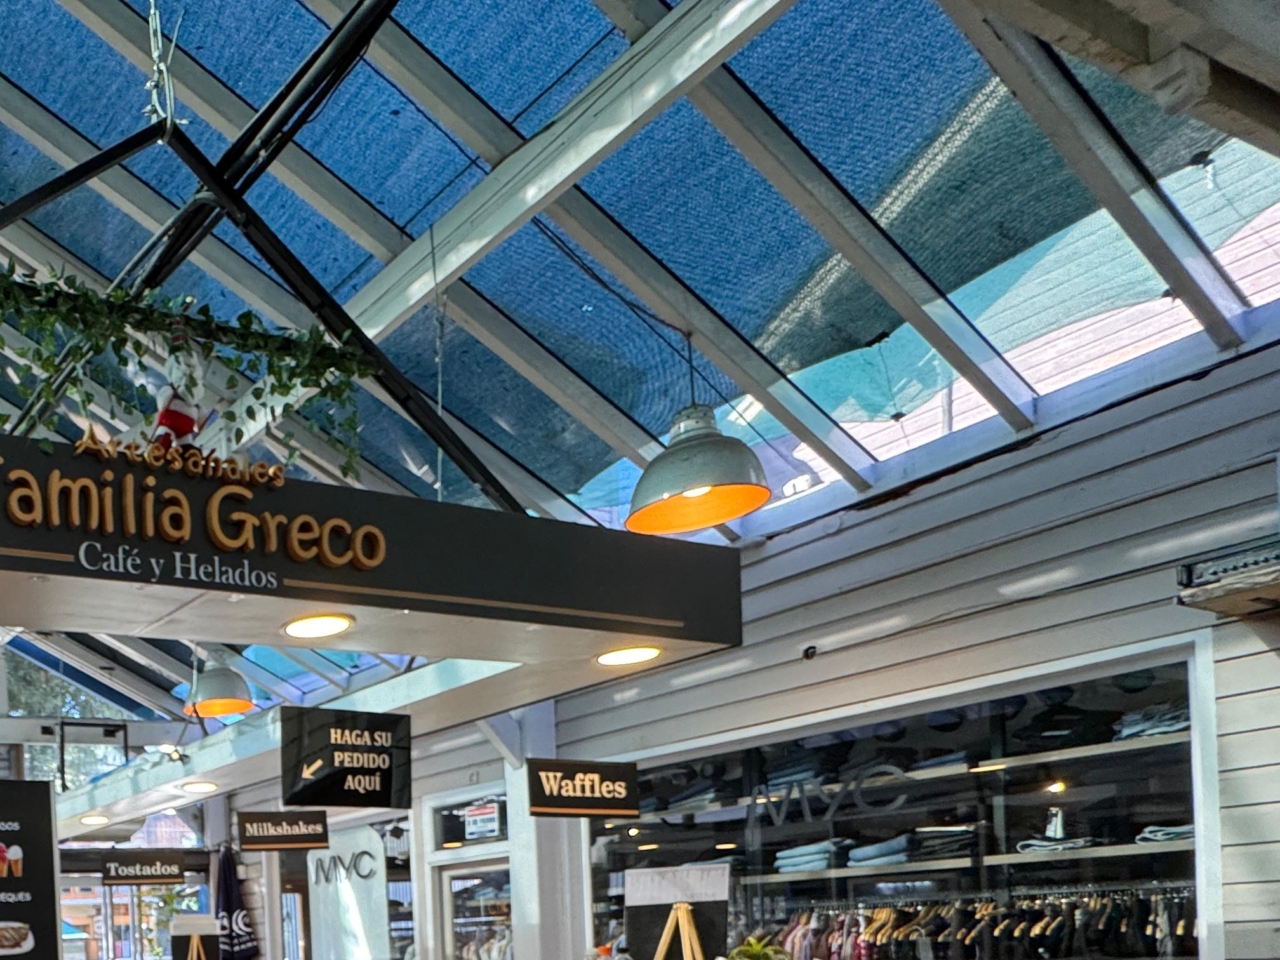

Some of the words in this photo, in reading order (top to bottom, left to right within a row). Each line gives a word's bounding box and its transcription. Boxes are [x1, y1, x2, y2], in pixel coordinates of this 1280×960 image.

[206, 484, 387, 571] Greco
[78, 540, 141, 576] Café
[150, 556, 166, 583] y
[173, 551, 279, 590] Helados
[330, 728, 372, 746] HAGA
[373, 731, 392, 748] SU
[333, 751, 390, 769] PEDIDO
[344, 771, 382, 794] AQUÍ
[538, 770, 628, 799] Waffles
[243, 818, 325, 837] Milkshakes
[106, 860, 180, 878] Tostados
[314, 850, 378, 885] MYC
